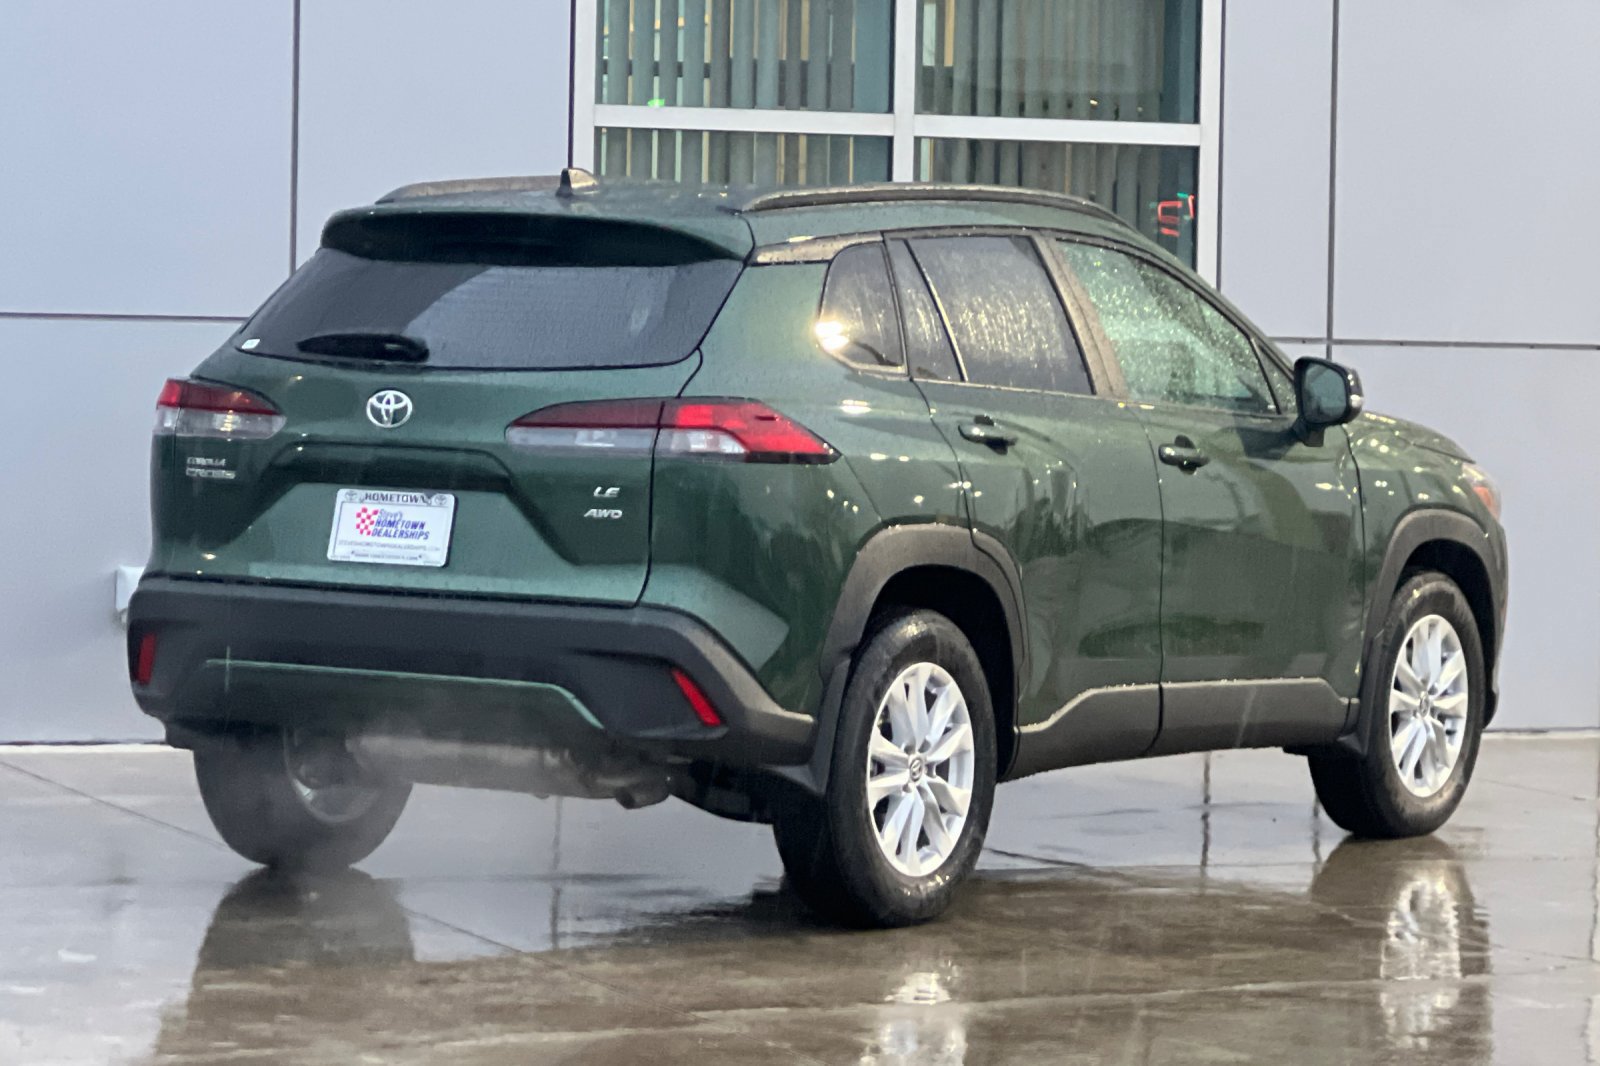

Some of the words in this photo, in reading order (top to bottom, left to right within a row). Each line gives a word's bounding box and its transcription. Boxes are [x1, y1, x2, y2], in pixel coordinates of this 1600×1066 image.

[593, 486, 620, 498] LE
[583, 508, 623, 519] AWD
[375, 518, 426, 530] HOMETOWN
[371, 528, 430, 541] DEALERSHIPS
